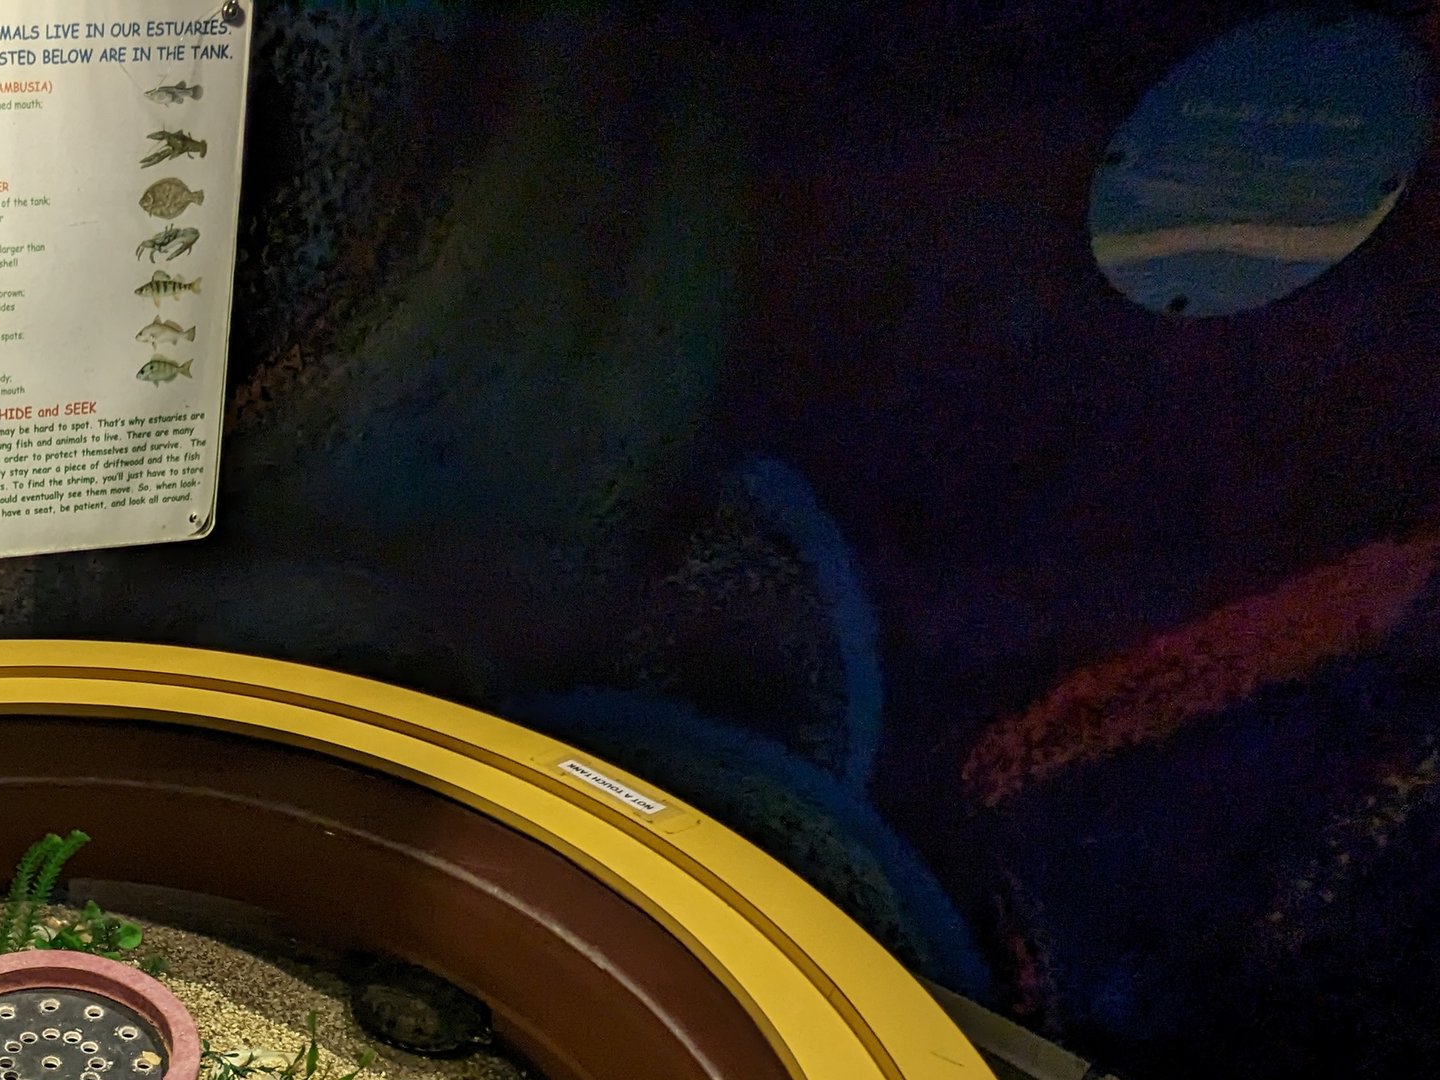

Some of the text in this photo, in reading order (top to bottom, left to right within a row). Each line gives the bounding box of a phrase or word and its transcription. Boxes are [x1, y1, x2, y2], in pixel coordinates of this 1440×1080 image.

[46, 24, 79, 39] LIVE
[86, 24, 104, 37] IN
[111, 23, 140, 37] OUR
[147, 20, 232, 36] ESTUARIES.
[43, 49, 93, 64] BELOW
[100, 47, 126, 62] ARE
[132, 47, 151, 61] IN
[157, 45, 185, 60] THE
[191, 44, 232, 59] TANK.
[14, 99, 42, 109] mouth;
[0, 402, 96, 420] HIDE and SEEK
[19, 426, 30, 434] be
[34, 423, 54, 432] hard
[72, 421, 92, 431] spot.
[98, 418, 125, 427] That's
[129, 416, 145, 426] why
[148, 414, 187, 423] estuaries
[16, 439, 33, 448] fish
[37, 437, 52, 446] and
[56, 435, 87, 445] animals
[104, 433, 121, 441] live.
[173, 428, 194, 436] many
[4, 453, 28, 462] order
[45, 450, 77, 462] protect
[82, 447, 128, 456] themselves
[132, 442, 147, 452] and
[10, 468, 29, 477] stay
[64, 464, 86, 474] piece
[90, 460, 99, 469] of
[103, 457, 144, 468] driftwood
[148, 455, 162, 464] and
[166, 454, 180, 462] the
[184, 452, 200, 461] fish
[12, 481, 24, 489] To
[28, 479, 45, 488] find
[49, 478, 62, 486] the
[67, 476, 98, 485] shrimp,
[102, 472, 123, 484] you'll
[126, 471, 143, 482] just
[21, 491, 64, 501] eventually
[86, 488, 107, 496] them
[138, 483, 151, 491] So,
[180, 479, 200, 488] look-
[34, 506, 55, 514] seat,
[60, 504, 70, 512] be
[74, 502, 106, 512] patient,
[111, 498, 126, 507] and
[129, 497, 145, 505] look
[149, 495, 158, 503] all
[162, 493, 192, 502] around.
[567, 763, 592, 777] TANK
[592, 776, 623, 794] TOUCH
[632, 798, 654, 810] NOT
